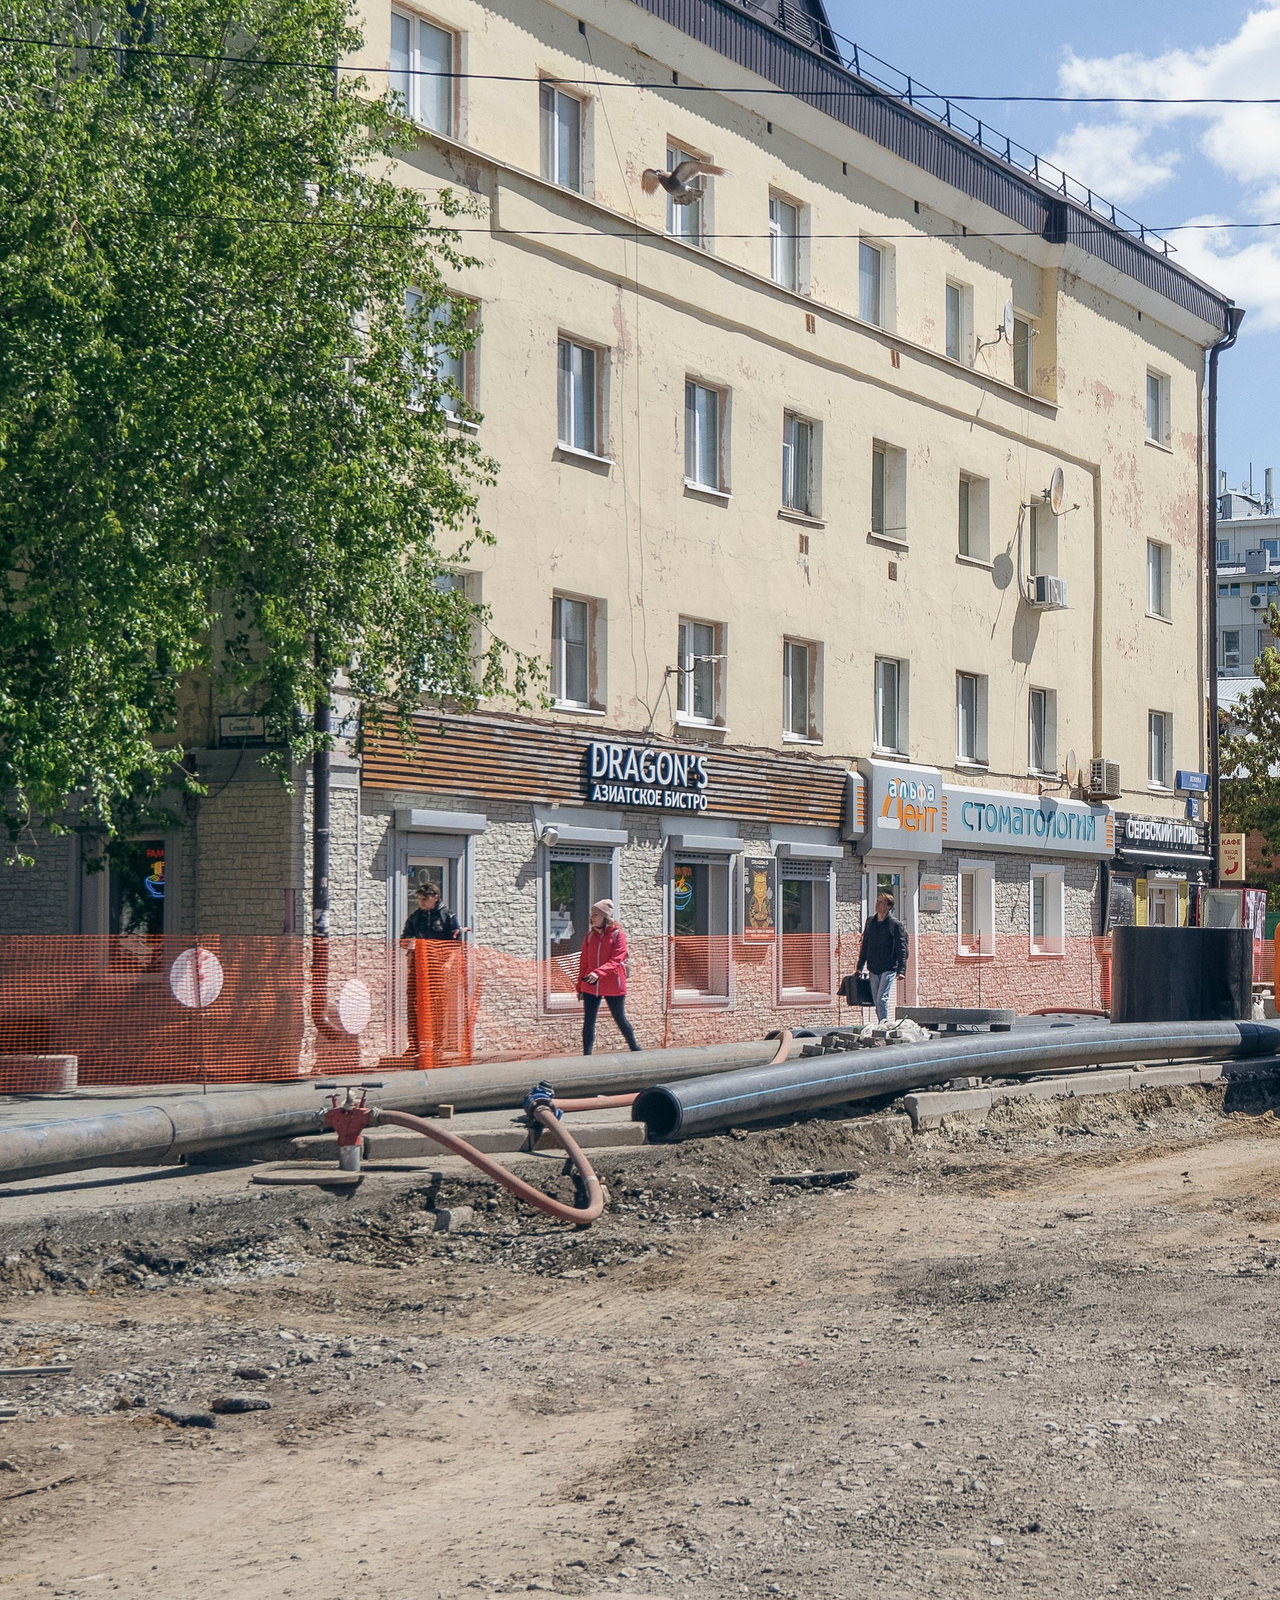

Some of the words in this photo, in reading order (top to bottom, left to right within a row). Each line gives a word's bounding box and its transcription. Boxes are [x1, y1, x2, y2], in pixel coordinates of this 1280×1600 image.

[593, 784, 662, 806] АЗИАТСКОЕ
[664, 790, 708, 810] БИСТРО
[888, 778, 935, 806] альфа
[1126, 819, 1173, 842] СЕРБСКИЙ
[1174, 824, 1199, 845] ГРИЛЬ
